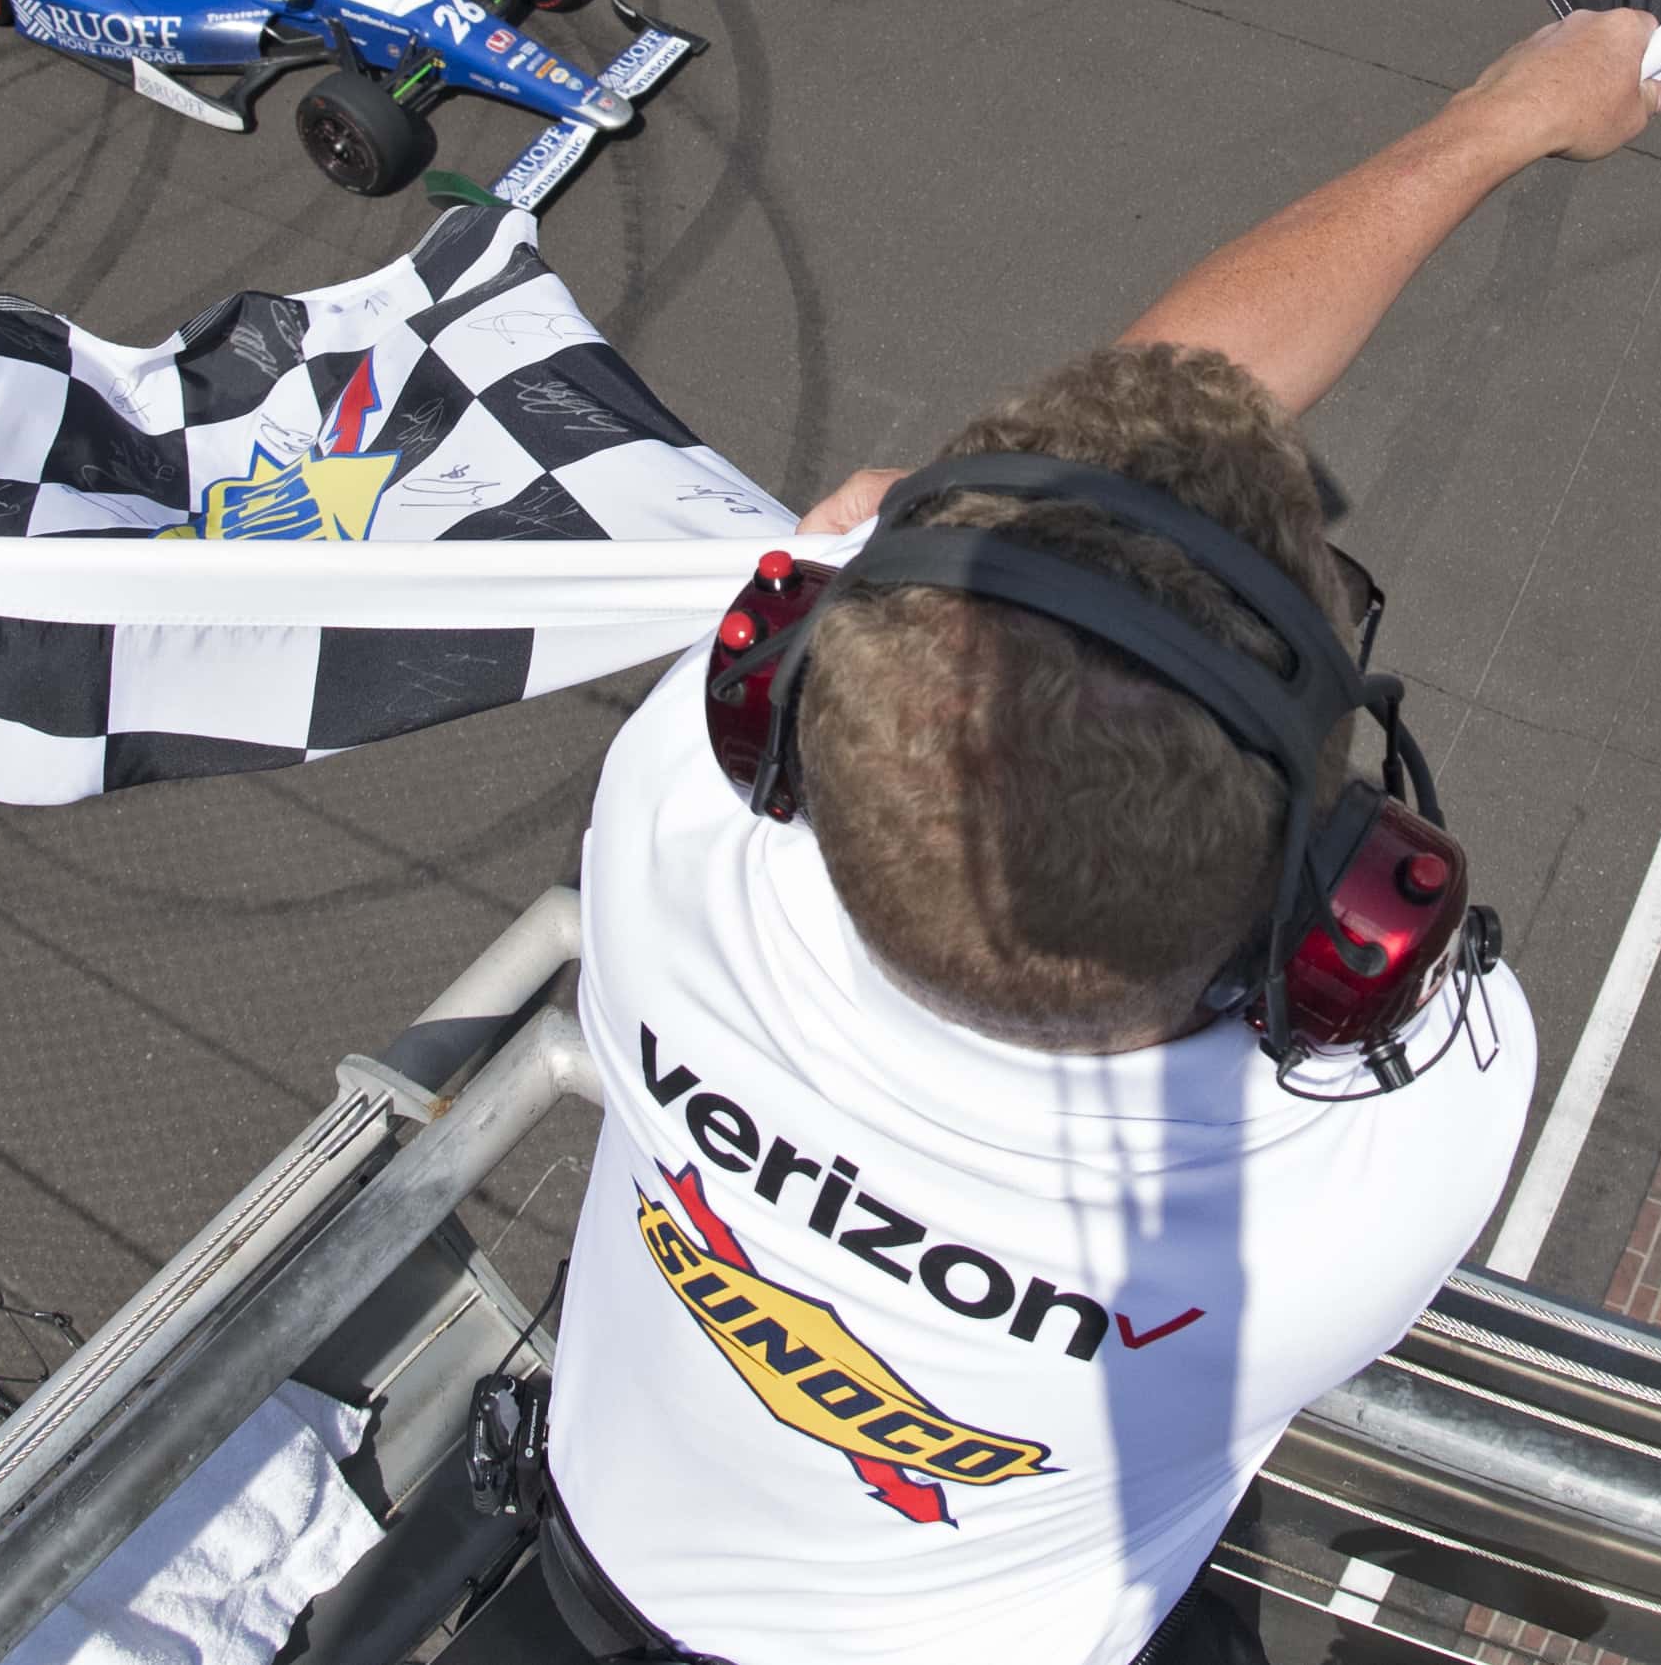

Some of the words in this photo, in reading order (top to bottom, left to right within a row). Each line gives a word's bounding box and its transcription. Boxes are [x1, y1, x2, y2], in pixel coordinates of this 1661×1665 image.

[45, 3, 182, 50] RUOFF
[206, 9, 270, 24] Firestone
[57, 35, 98, 55] HOME
[616, 27, 664, 78] RUOFF
[618, 39, 687, 95] Panasonic
[149, 80, 204, 116] RUOFF
[509, 124, 564, 183] RUOFF
[519, 136, 588, 208] Panasonic
[640, 1021, 1110, 1363] verizon
[644, 1221, 1028, 1479] SUNOCO
